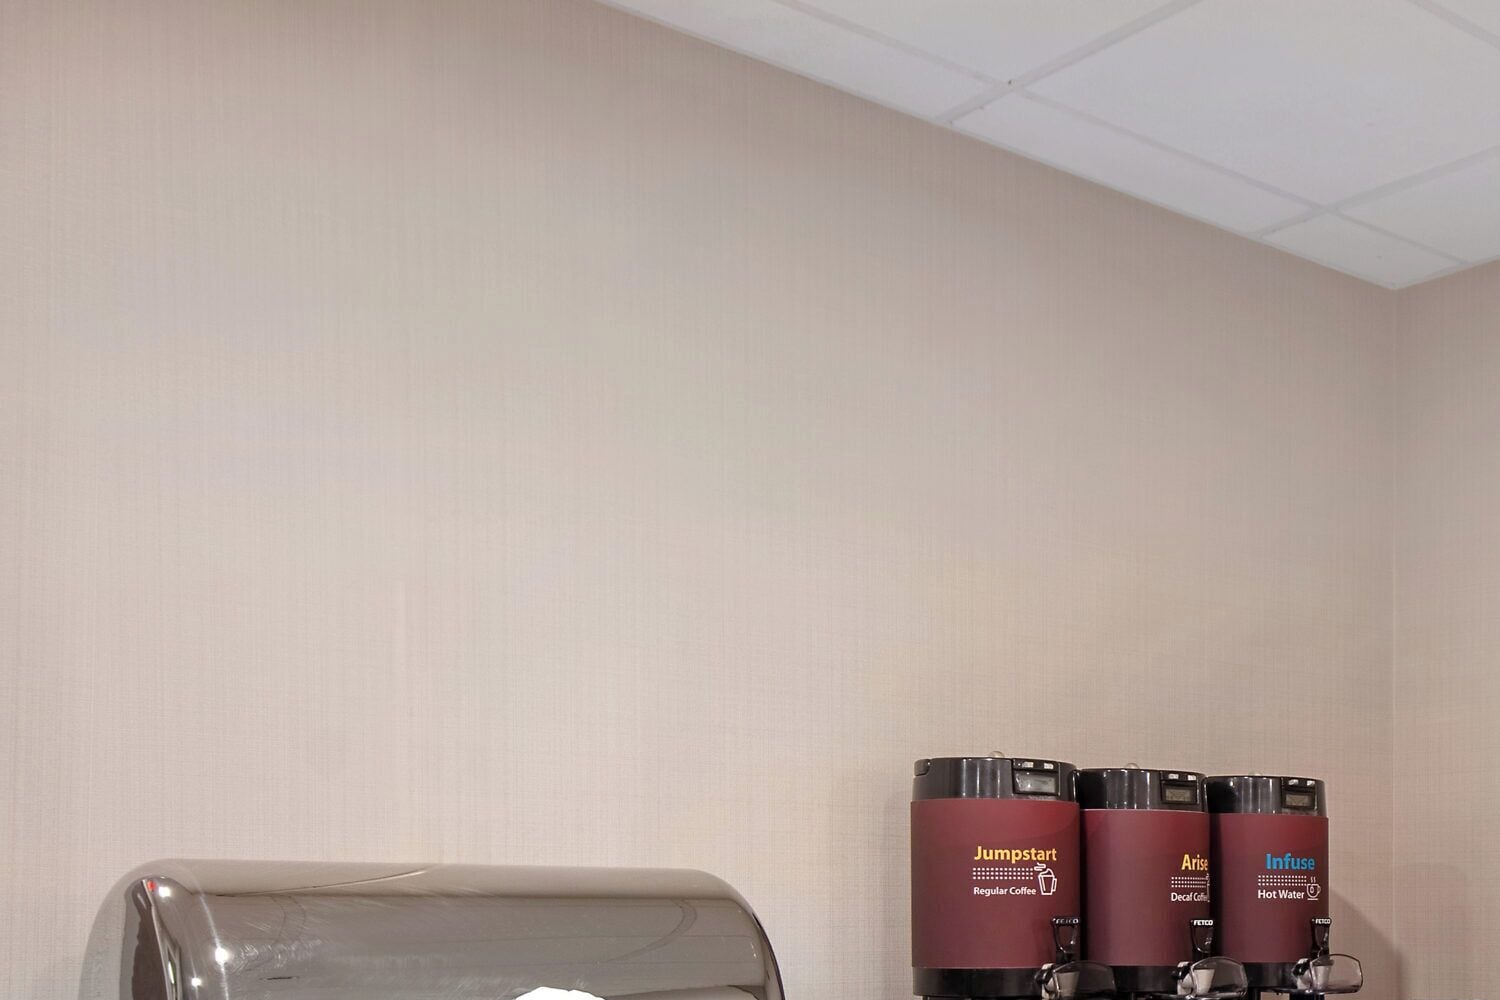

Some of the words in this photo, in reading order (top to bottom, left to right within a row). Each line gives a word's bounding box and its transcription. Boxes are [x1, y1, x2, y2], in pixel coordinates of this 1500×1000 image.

[974, 846, 1057, 864] Jumpstart
[1266, 853, 1315, 870] Infuse
[1181, 854, 1208, 870] Arise
[973, 887, 1007, 897] Regular
[1009, 887, 1037, 895] Coffee
[1171, 892, 1193, 901] Decaf
[1258, 890, 1277, 899] Hot
[1279, 889, 1305, 899] Water
